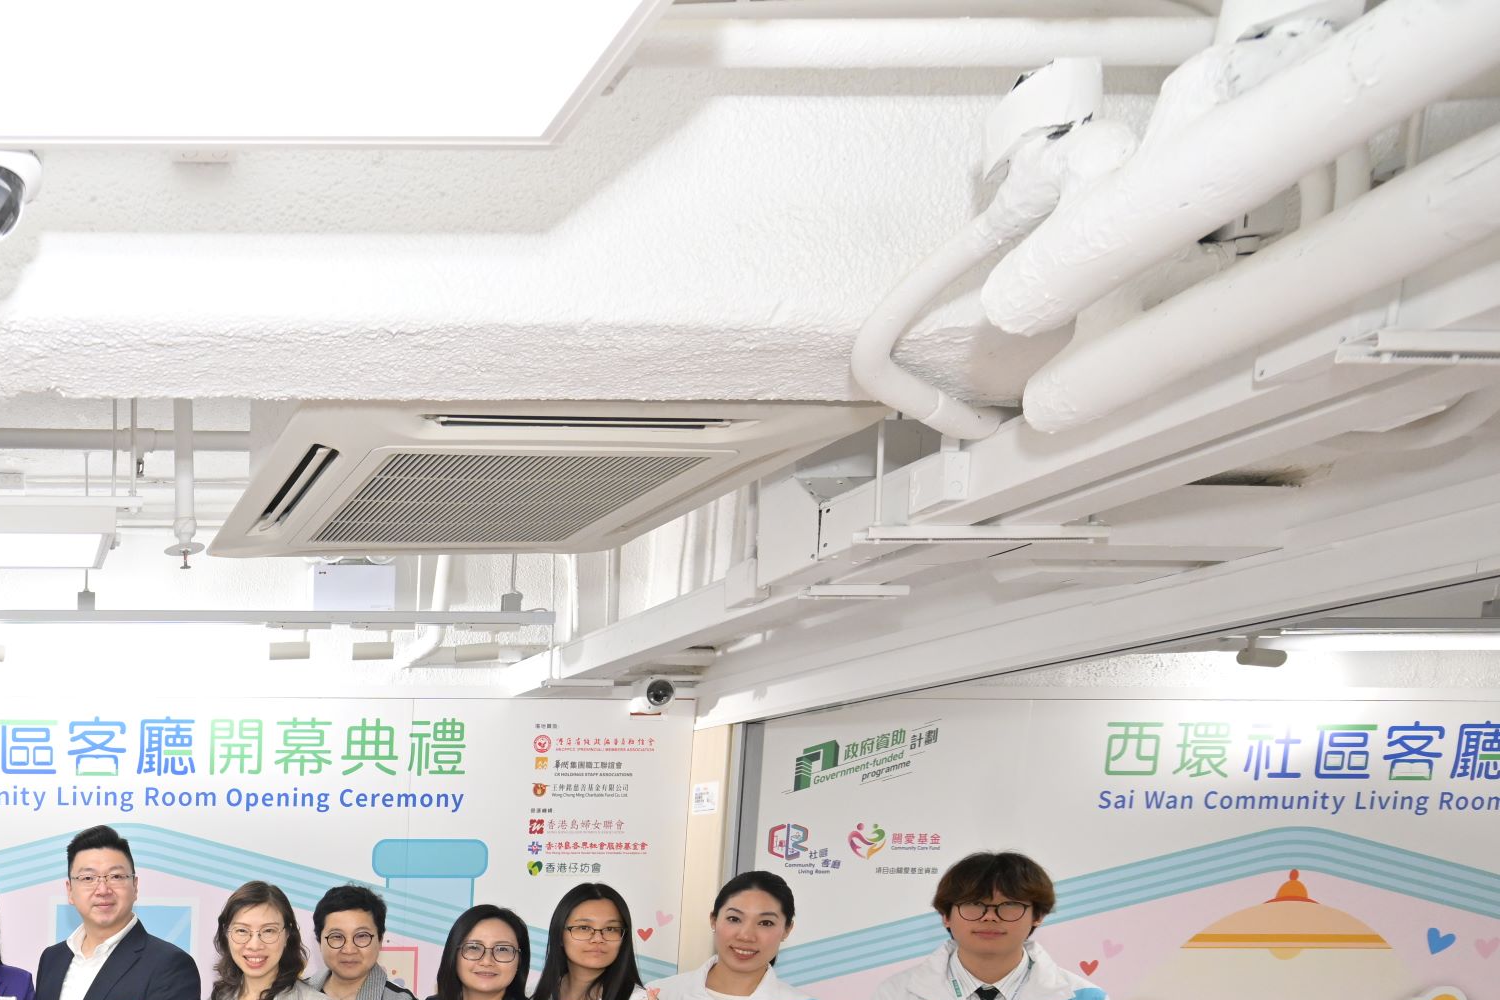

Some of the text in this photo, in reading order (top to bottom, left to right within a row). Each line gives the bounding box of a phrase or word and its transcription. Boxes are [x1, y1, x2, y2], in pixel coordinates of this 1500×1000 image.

[843, 727, 939, 761] 政府資助 計劃
[1104, 720, 1500, 781] 西環社區客廳
[813, 750, 904, 785] Government-funded
[861, 759, 911, 782] programme
[57, 785, 134, 812] Living
[144, 787, 216, 807] Room
[226, 787, 330, 812] Opening
[339, 788, 464, 813] Ceremony
[1098, 789, 1135, 810] Sai
[1144, 790, 1194, 810] Wan
[1203, 789, 1346, 815] Community
[1355, 790, 1429, 816] Living
[547, 819, 625, 830] 香港島婦女聯會
[891, 833, 941, 845] 關愛基金
[545, 862, 602, 873] 香港仔坊會
